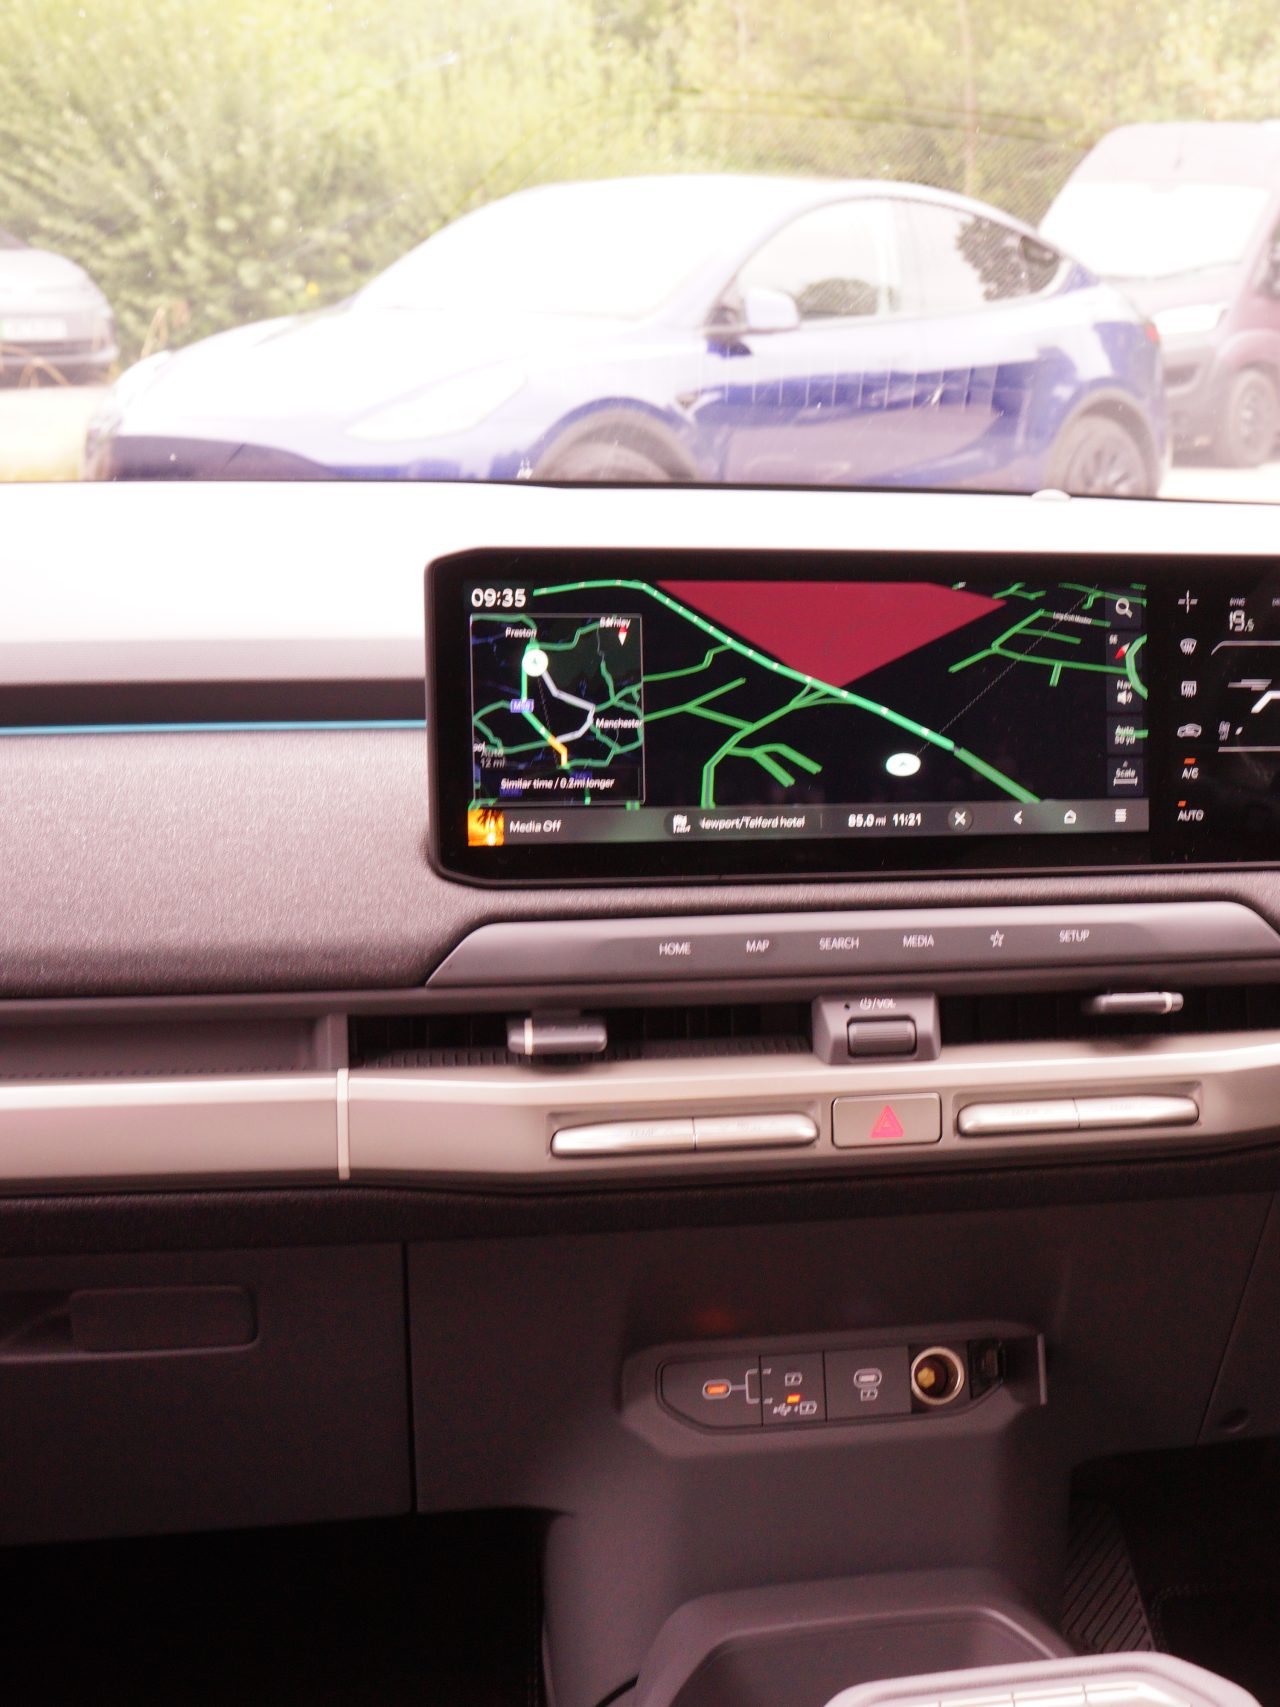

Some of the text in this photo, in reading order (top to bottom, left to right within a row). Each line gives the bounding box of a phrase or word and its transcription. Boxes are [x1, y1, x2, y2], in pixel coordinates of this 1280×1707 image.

[471, 588, 527, 608] 09:35
[505, 627, 537, 638] Preston
[595, 718, 645, 730] Manchester
[1182, 767, 1199, 780] A/C
[501, 778, 531, 789] Similar
[533, 778, 553, 789] time
[586, 777, 615, 790] longer
[780, 816, 806, 828] hotel
[892, 812, 922, 827] 11:21
[1178, 809, 1205, 822] AUTO
[509, 819, 562, 833] Media Off
[902, 934, 935, 948] MEDIA
[1059, 929, 1090, 943] SETUP
[659, 941, 692, 956] HOME
[746, 939, 770, 953] MAP
[819, 936, 860, 951] SEARCH
